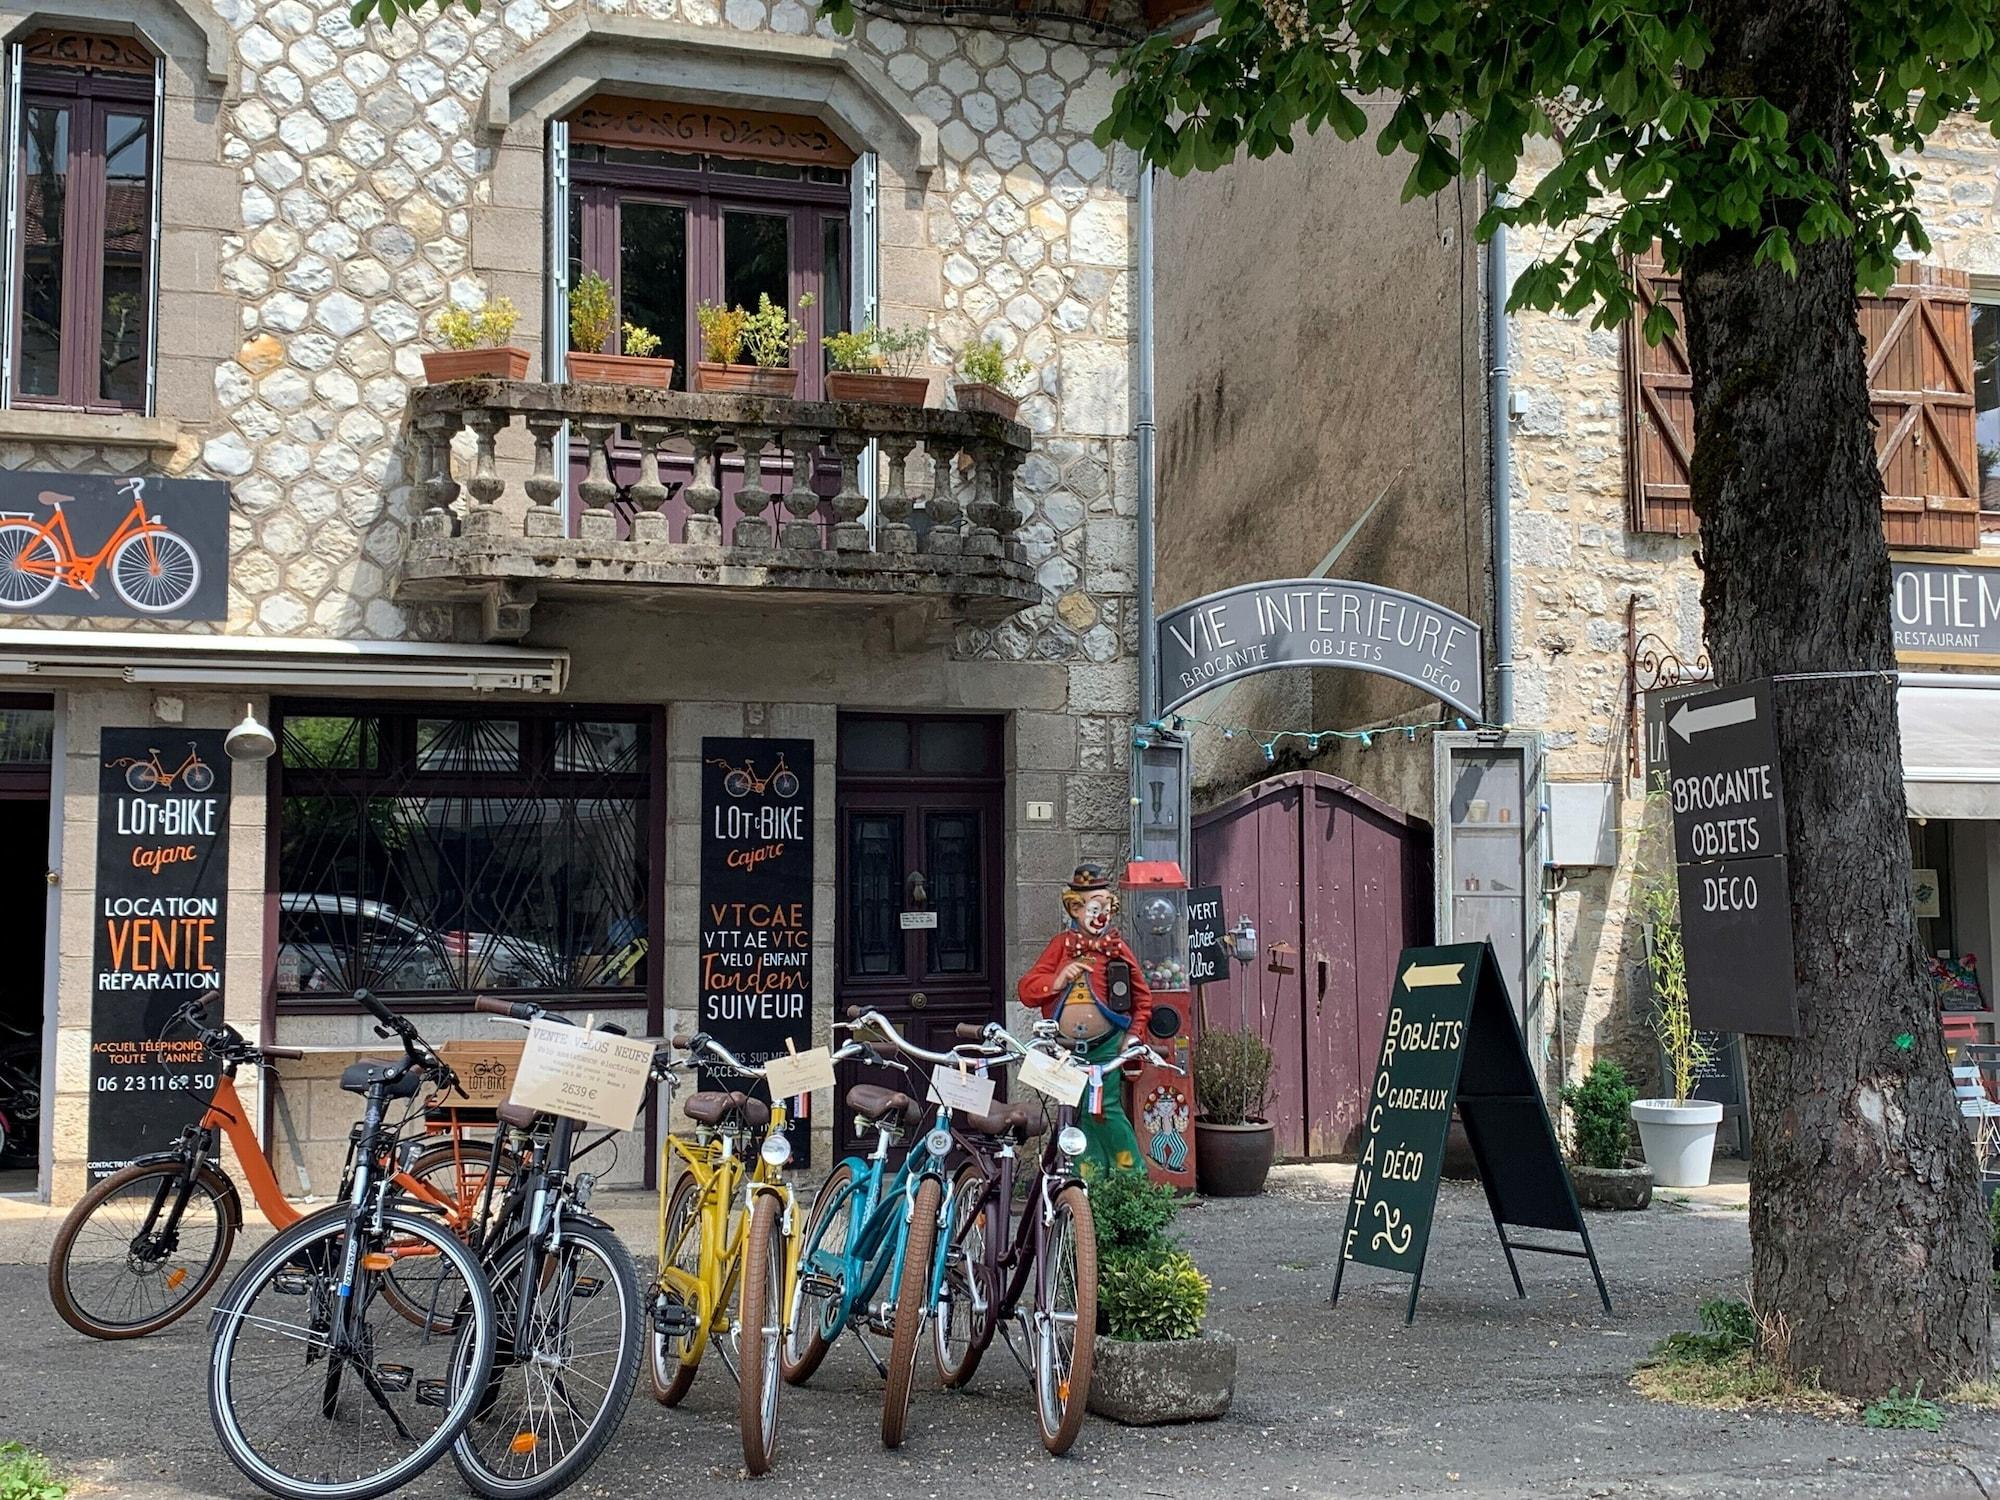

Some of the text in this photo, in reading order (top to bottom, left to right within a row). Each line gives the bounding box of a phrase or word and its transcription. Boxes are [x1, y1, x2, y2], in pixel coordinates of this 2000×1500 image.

[1895, 571, 2000, 628] OHEM
[1169, 587, 1467, 666] VIE INTÉRIEURE
[1894, 630, 1980, 648] RESTAURANT
[1180, 638, 1461, 694] BROCANTE OBJETS DÉCO
[1672, 764, 1773, 814] BROCANTE
[1691, 817, 1760, 856] OBJETS
[132, 845, 198, 874] Cajarc
[727, 843, 784, 872] Cajarc
[1702, 866, 1758, 912] DÉCO
[104, 897, 217, 917] LOCATION
[107, 919, 215, 971] VENTE
[772, 931, 808, 948] VTC
[702, 952, 809, 994] Tandem
[720, 953, 808, 966] VELO ENFANT
[99, 968, 220, 990] RÉPARATION
[707, 994, 804, 1020] SUIVEUR
[93, 1041, 137, 1053] ACCUEIL
[532, 1027, 569, 1045] VENTE
[614, 1045, 651, 1064] NEUFS
[1400, 1014, 1463, 1051] OBJETS
[110, 1054, 147, 1064] TOUTE
[97, 1076, 118, 1091] 06
[124, 1076, 146, 1091] 23
[149, 1076, 164, 1090] 11
[194, 1074, 214, 1090] 50
[1388, 1088, 1449, 1112] CADEAUX
[1344, 1007, 1402, 1260] BROCANTE
[1382, 1142, 1424, 1182] DÉCO
